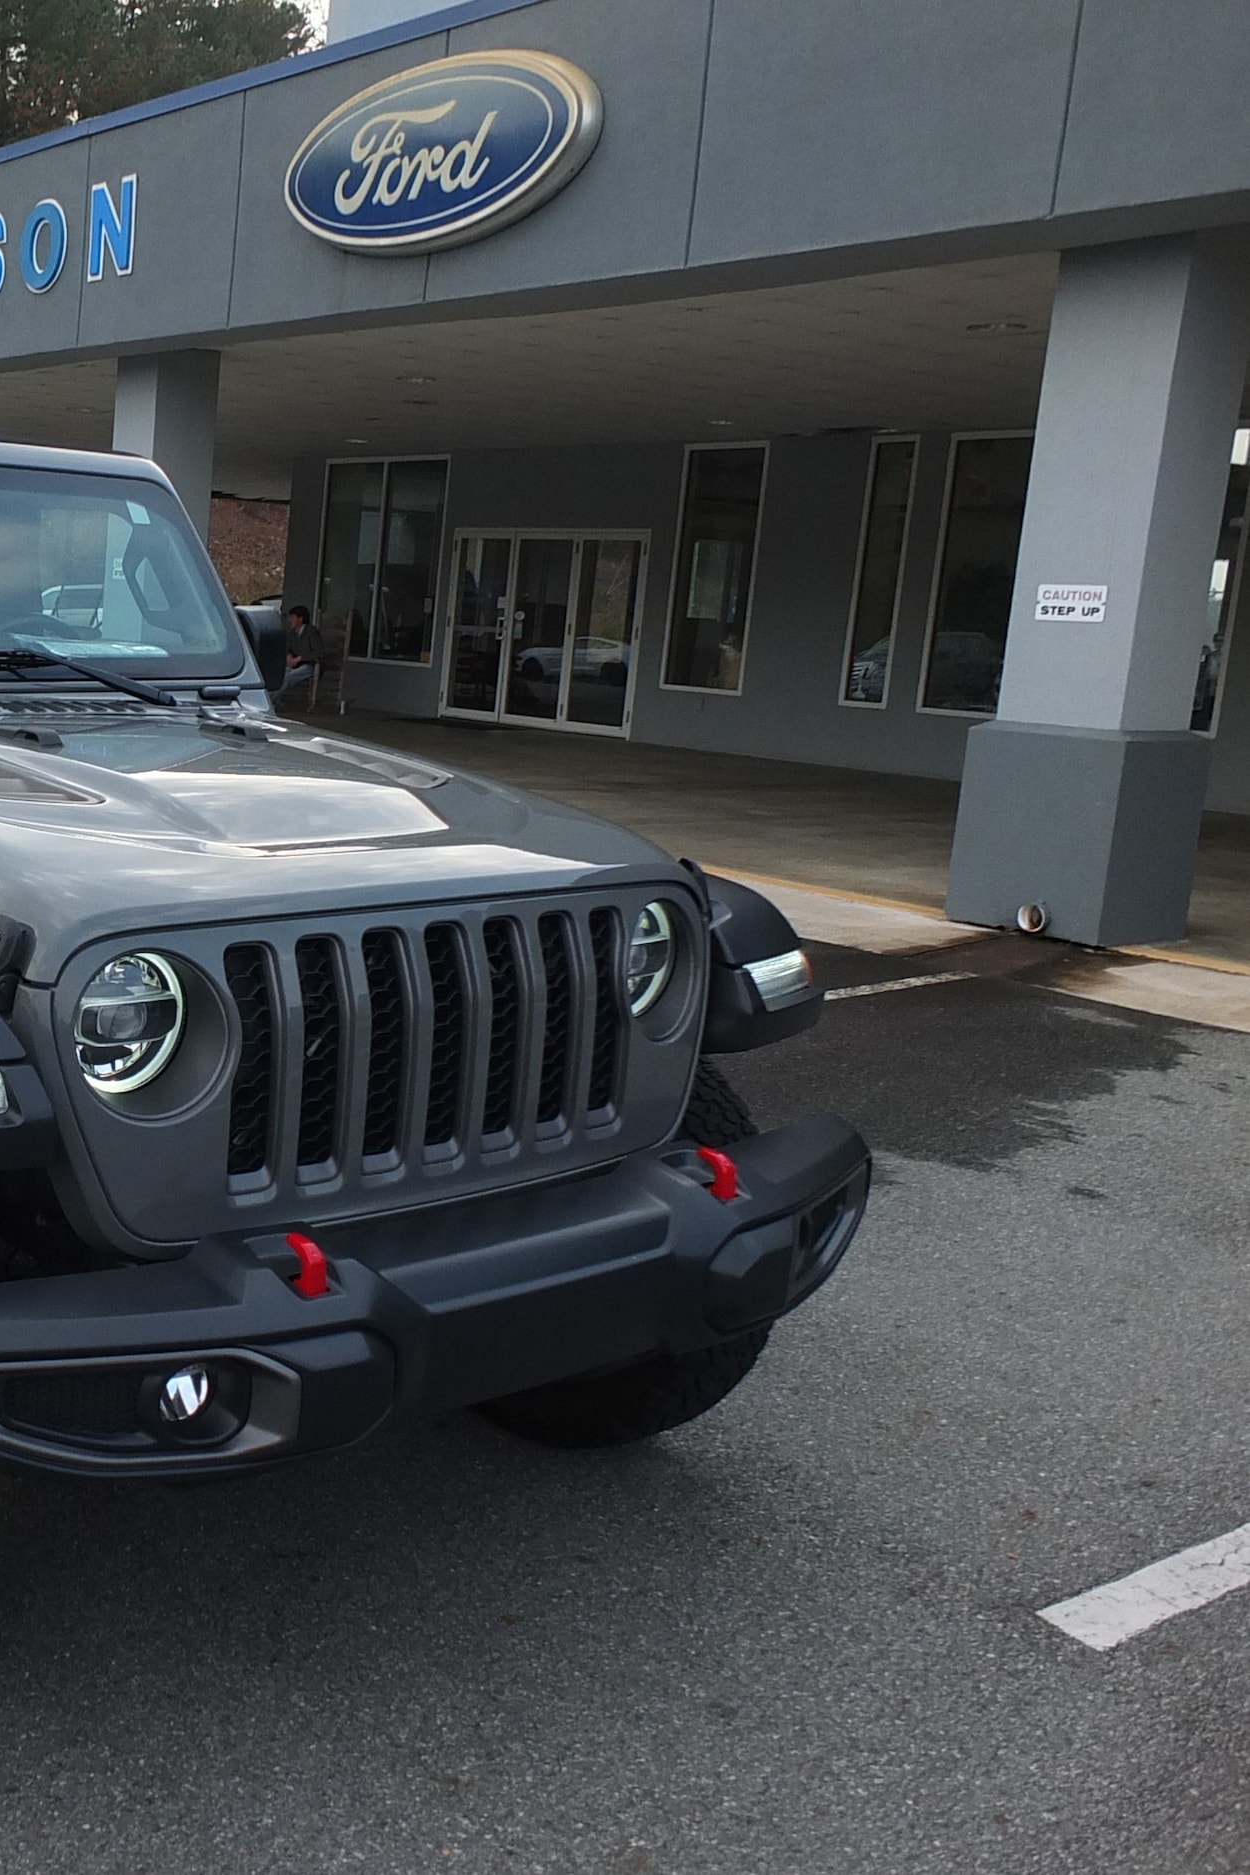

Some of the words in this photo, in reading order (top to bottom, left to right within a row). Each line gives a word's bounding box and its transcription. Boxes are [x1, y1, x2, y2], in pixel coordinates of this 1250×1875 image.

[333, 100, 498, 216] Ford
[1042, 590, 1103, 602] CAUTION
[1040, 605, 1076, 616] STEP
[1081, 606, 1101, 617] UP
